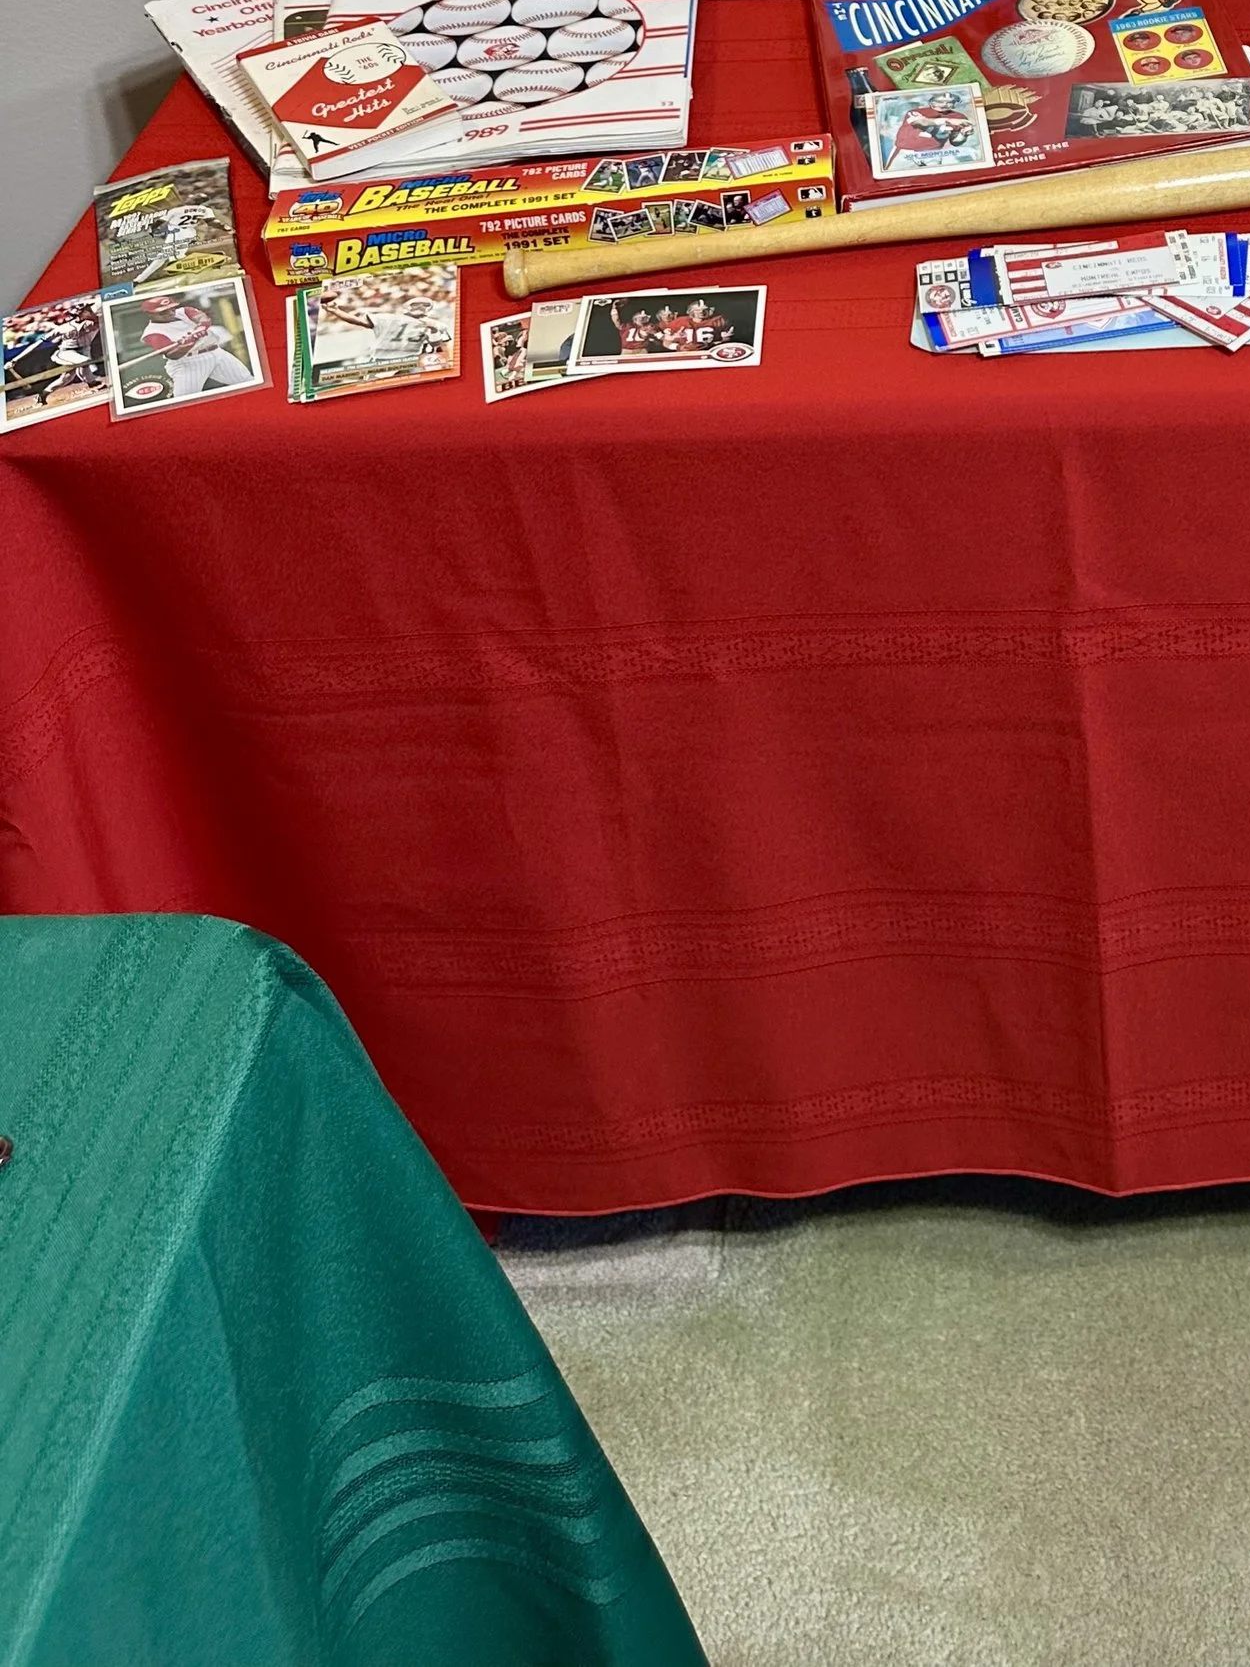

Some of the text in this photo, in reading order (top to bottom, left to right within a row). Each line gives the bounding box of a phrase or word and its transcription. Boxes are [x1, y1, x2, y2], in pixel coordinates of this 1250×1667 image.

[832, 2, 847, 21] THE
[1115, 12, 1198, 31] 1963 ROOKIE STARS
[356, 56, 373, 65] THE
[311, 77, 395, 117] Greatest
[343, 98, 392, 123] Hits
[457, 124, 509, 143] 989
[921, 148, 961, 158] MONTANA
[997, 140, 1025, 151] AND
[1023, 140, 1070, 155] OF THE
[995, 154, 1046, 167] ACHINE
[522, 162, 588, 177] 792 PICTURE
[552, 170, 588, 181] CARDS
[349, 177, 519, 214] BASEBALL
[424, 192, 577, 215] THE COMPLETE 1991 SET
[178, 214, 203, 227] 25
[480, 211, 587, 233] 792 PICTURE CARDS
[367, 229, 427, 245] MICRO
[504, 235, 570, 251] 1991 SET
[333, 236, 475, 275] BASEBALL
[683, 327, 714, 344] 16
